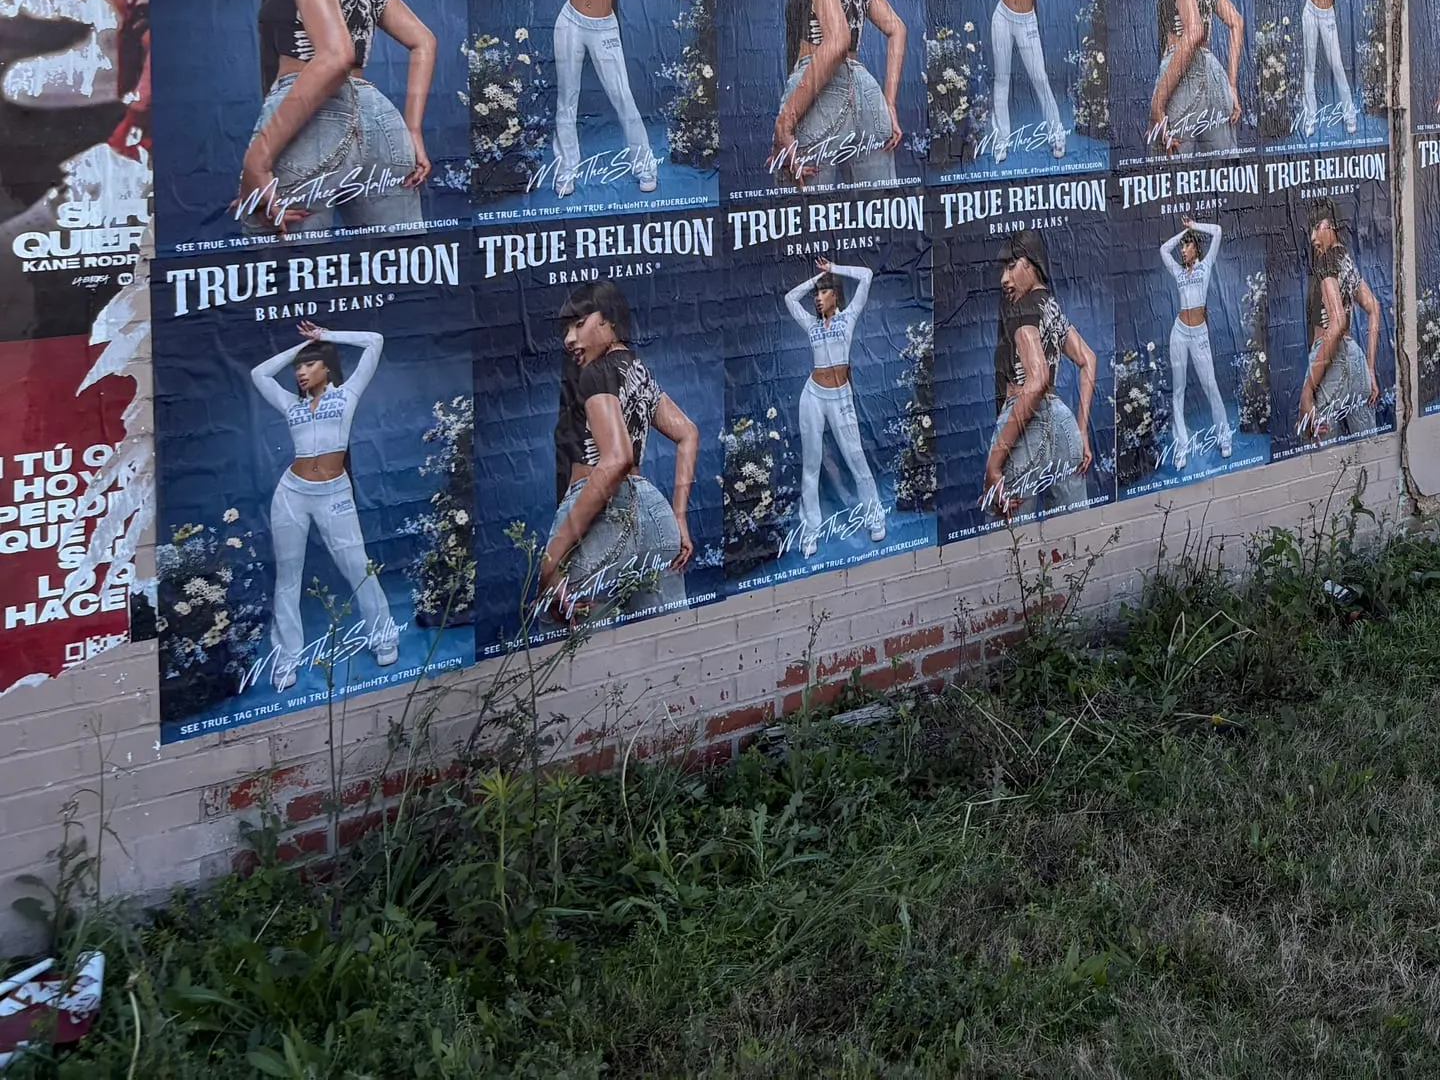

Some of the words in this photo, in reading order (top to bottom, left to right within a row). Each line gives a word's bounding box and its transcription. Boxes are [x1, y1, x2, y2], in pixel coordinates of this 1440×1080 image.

[1119, 173, 1170, 208] TRUE
[1176, 164, 1257, 194] RELIGION
[1265, 160, 1310, 192] TRUE
[1314, 153, 1384, 180] RELIGION
[940, 189, 1002, 227] TRUE
[1009, 179, 1104, 211] RELIGION
[1301, 187, 1326, 198] BRAND
[496, 210, 520, 218] TRUE.
[1160, 201, 1190, 214] BRAND
[175, 242, 195, 251] SEE
[197, 239, 227, 249] TRUE.
[229, 237, 249, 246] TAG
[251, 235, 279, 244] TRUE.
[284, 233, 302, 241] WIN
[304, 230, 332, 239] TRUE.
[334, 225, 385, 236] #TrueInHTX
[388, 218, 458, 232] @TRUERELIGION
[728, 206, 801, 249] TRUE
[809, 195, 923, 231] RELIGION
[989, 220, 1024, 234] BRAND
[478, 230, 566, 277] TRUE
[576, 218, 711, 257] RELIGION
[786, 240, 828, 256] BRAND
[22, 258, 80, 272] KANE
[548, 267, 599, 285] BRAND
[167, 260, 277, 315] TRUE
[289, 243, 458, 290] RELIGION
[254, 301, 317, 321] BRAND
[14, 443, 73, 476] TÚ
[738, 580, 751, 589] SEE
[774, 571, 787, 580] TAG
[810, 562, 822, 571] WIN
[484, 644, 500, 654] SEE
[528, 633, 544, 643] TAG
[180, 722, 200, 734] SEE
[201, 714, 231, 729] TRUE.
[233, 709, 253, 721] TAG
[254, 701, 283, 716] TRUE.
[287, 696, 305, 707] WIN
